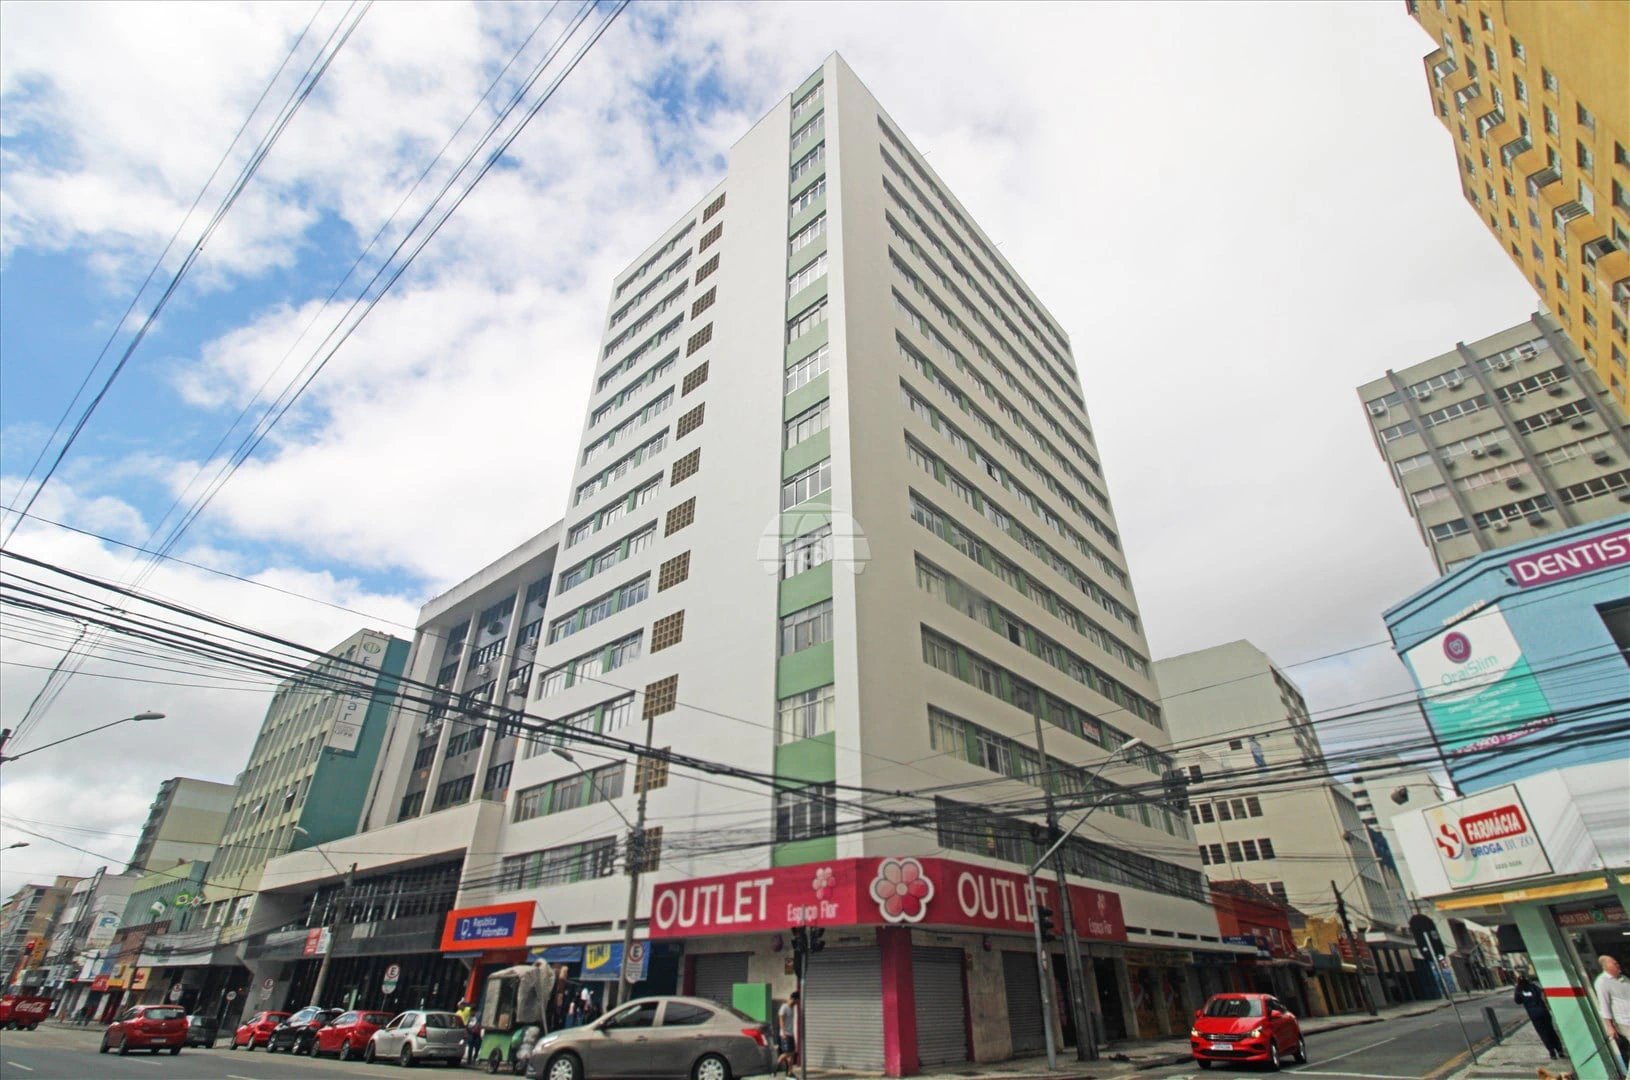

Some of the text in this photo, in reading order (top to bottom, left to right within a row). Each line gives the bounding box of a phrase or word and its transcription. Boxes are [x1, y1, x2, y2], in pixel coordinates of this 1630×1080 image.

[1465, 811, 1522, 841] FARMÁCIA
[1470, 842, 1504, 858] DROGA
[655, 877, 774, 930] OUTLET
[820, 900, 839, 920] Flor
